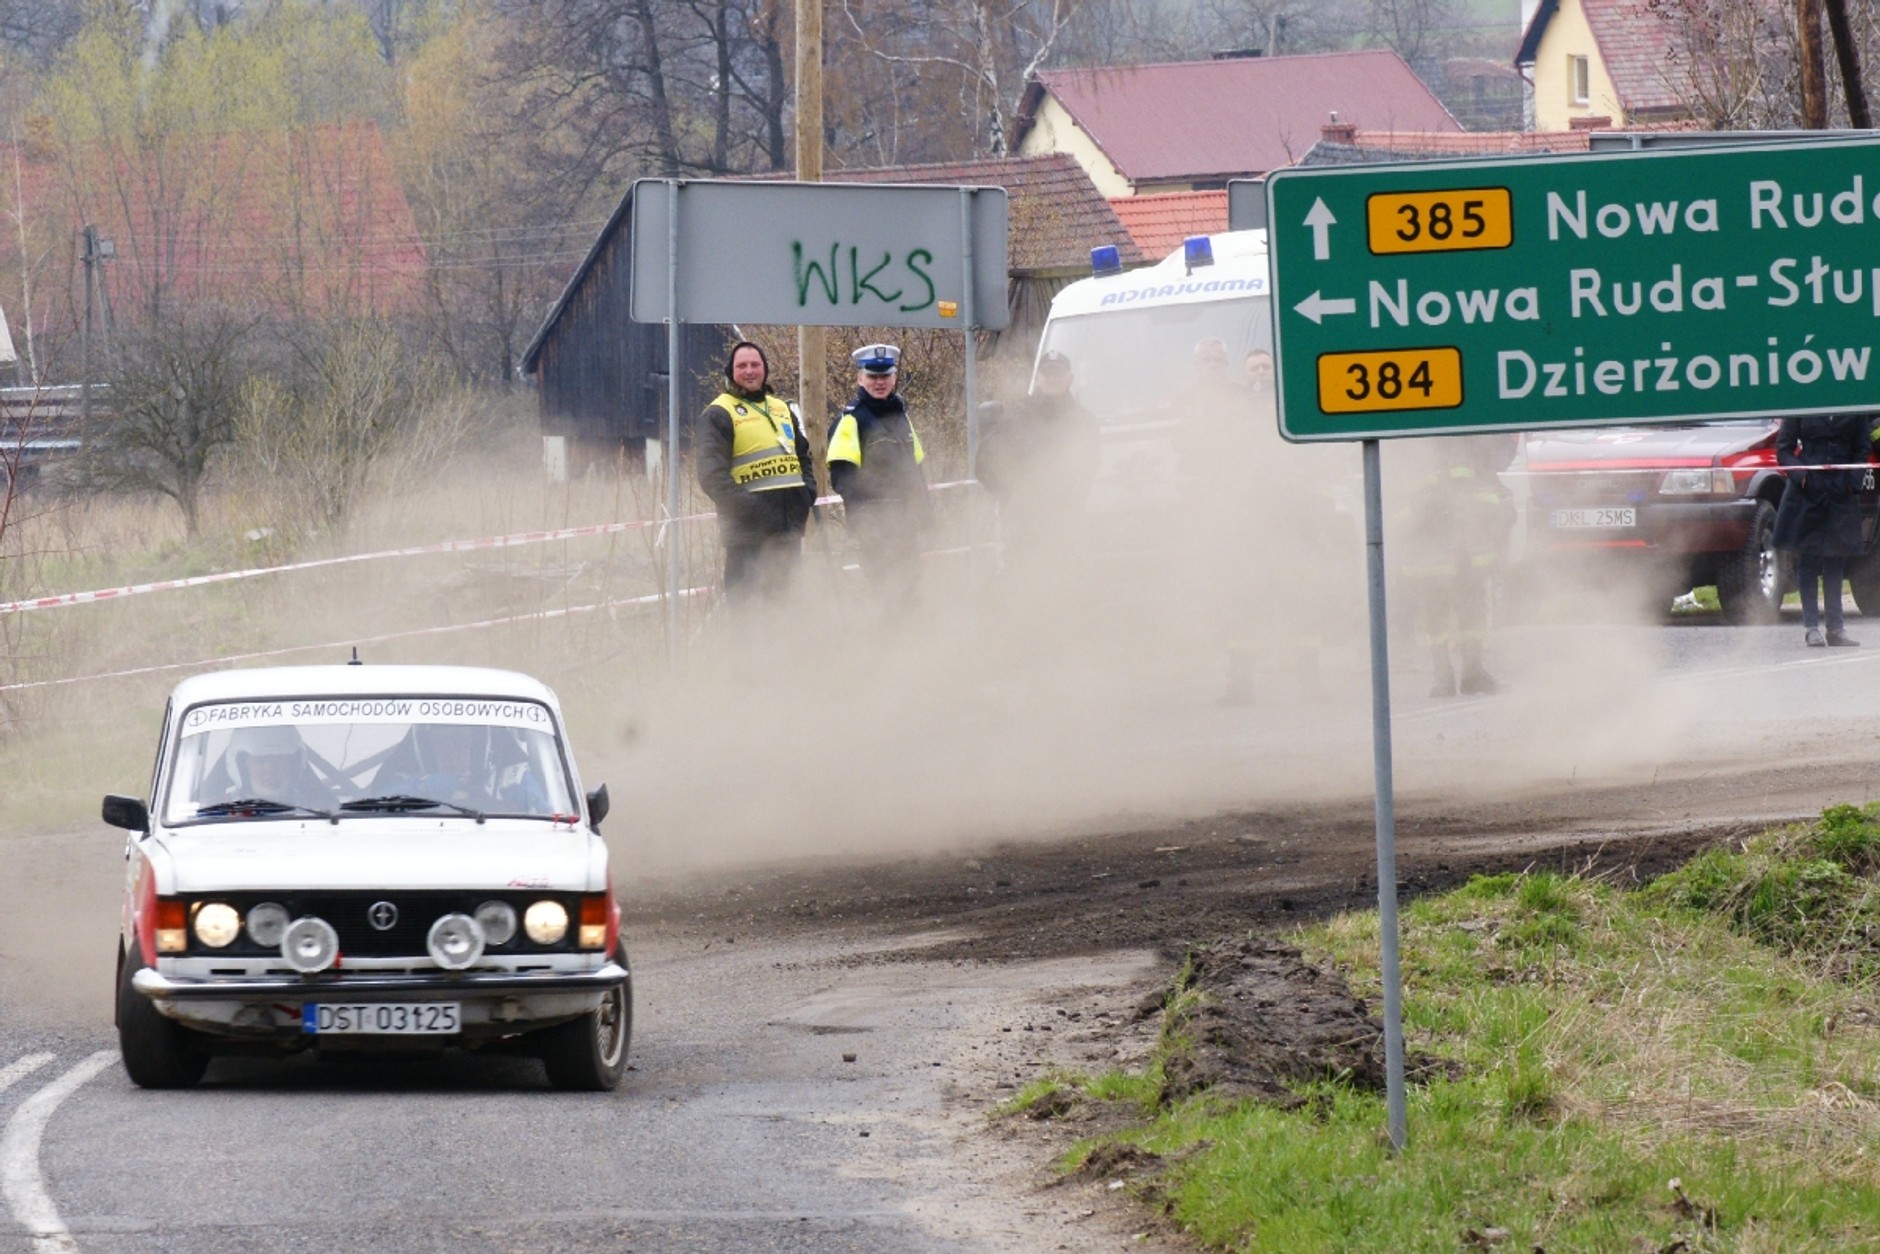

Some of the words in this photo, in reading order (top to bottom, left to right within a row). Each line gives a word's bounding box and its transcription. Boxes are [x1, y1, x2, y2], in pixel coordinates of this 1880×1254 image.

[1396, 201, 1485, 241] 385
[1547, 190, 1719, 240] Nowa
[1750, 175, 1880, 229] Rud
[793, 241, 935, 312] WKS
[1369, 279, 1540, 328] Nowa
[1570, 256, 1880, 318] Ruda-Słu
[1345, 361, 1433, 400] 384
[1498, 334, 1871, 400] Dzierżoniów
[1596, 509, 1633, 525] 25MS
[208, 705, 283, 722] FABRYKA
[292, 699, 413, 716] SAMOCHODÓW
[419, 703, 524, 718] OSOBOWYCH
[319, 1006, 367, 1030] DST
